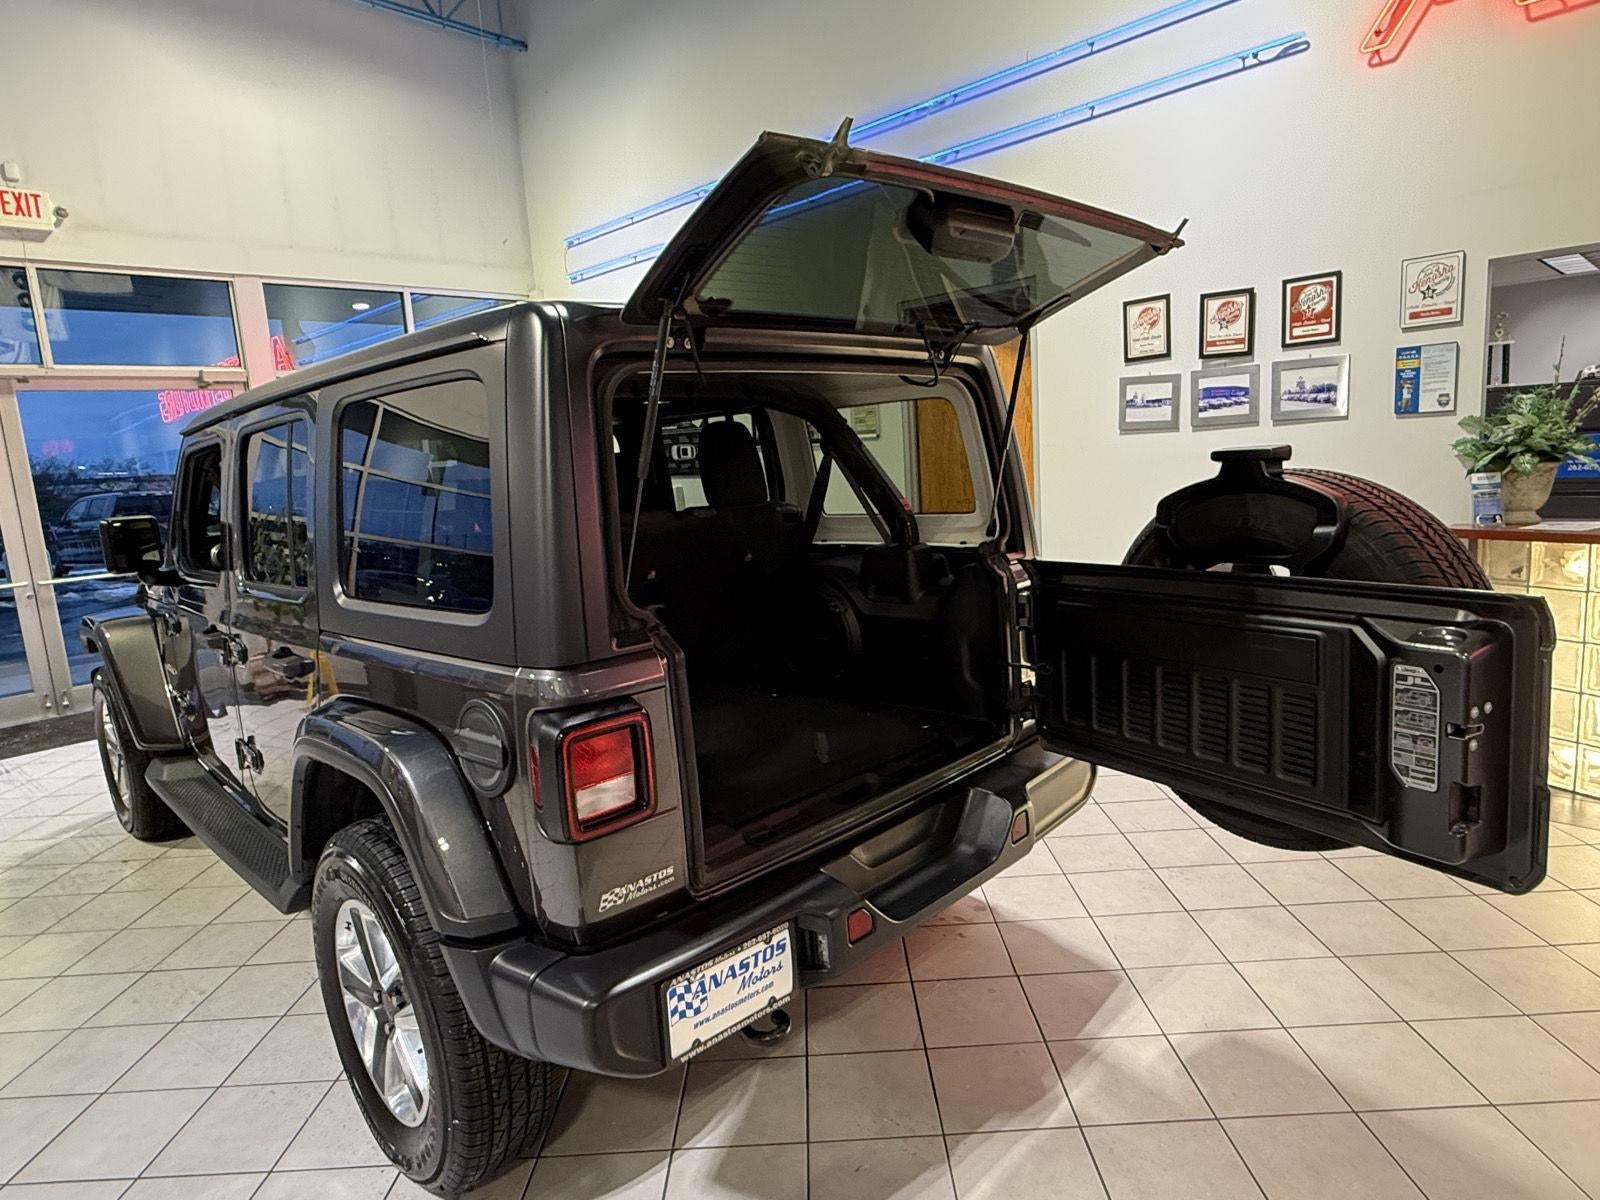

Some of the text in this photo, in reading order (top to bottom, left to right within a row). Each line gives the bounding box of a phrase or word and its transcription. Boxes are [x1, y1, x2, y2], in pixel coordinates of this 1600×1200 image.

[0, 190, 41, 219] EXIT
[618, 865, 674, 897] ANASTOS
[692, 937, 787, 1000] ANASTOS
[737, 960, 783, 994] Motors
[693, 981, 774, 1030] www.anastosmotors.com
[680, 995, 791, 1063] www.anastosmotors.com
